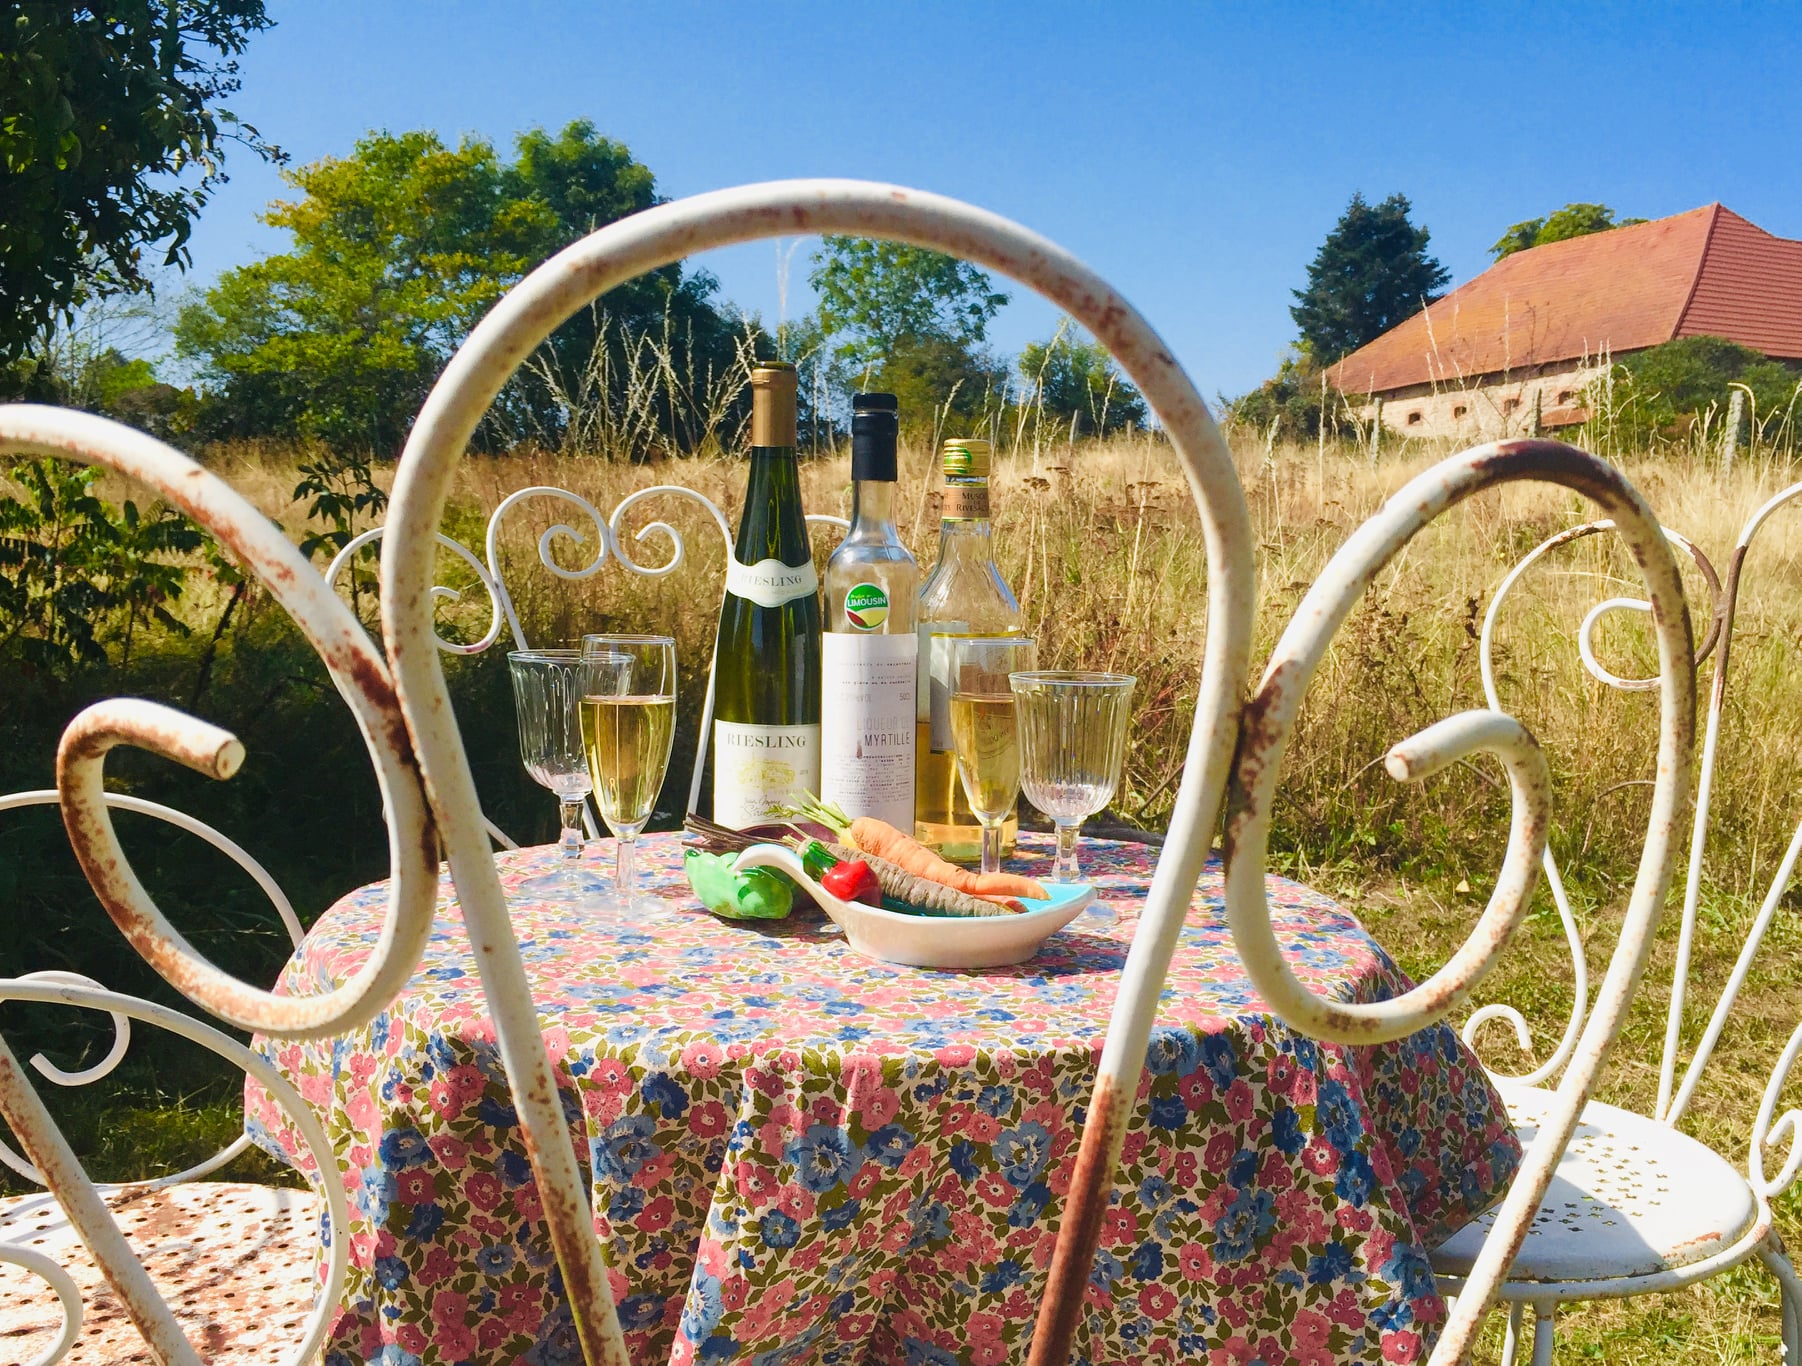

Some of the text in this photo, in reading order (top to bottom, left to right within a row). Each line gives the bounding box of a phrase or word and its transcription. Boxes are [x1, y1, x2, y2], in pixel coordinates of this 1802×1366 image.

[847, 596, 887, 607] LIMOUSIN
[727, 733, 807, 749] RIESLING
[864, 731, 910, 747] MYRTILLE
